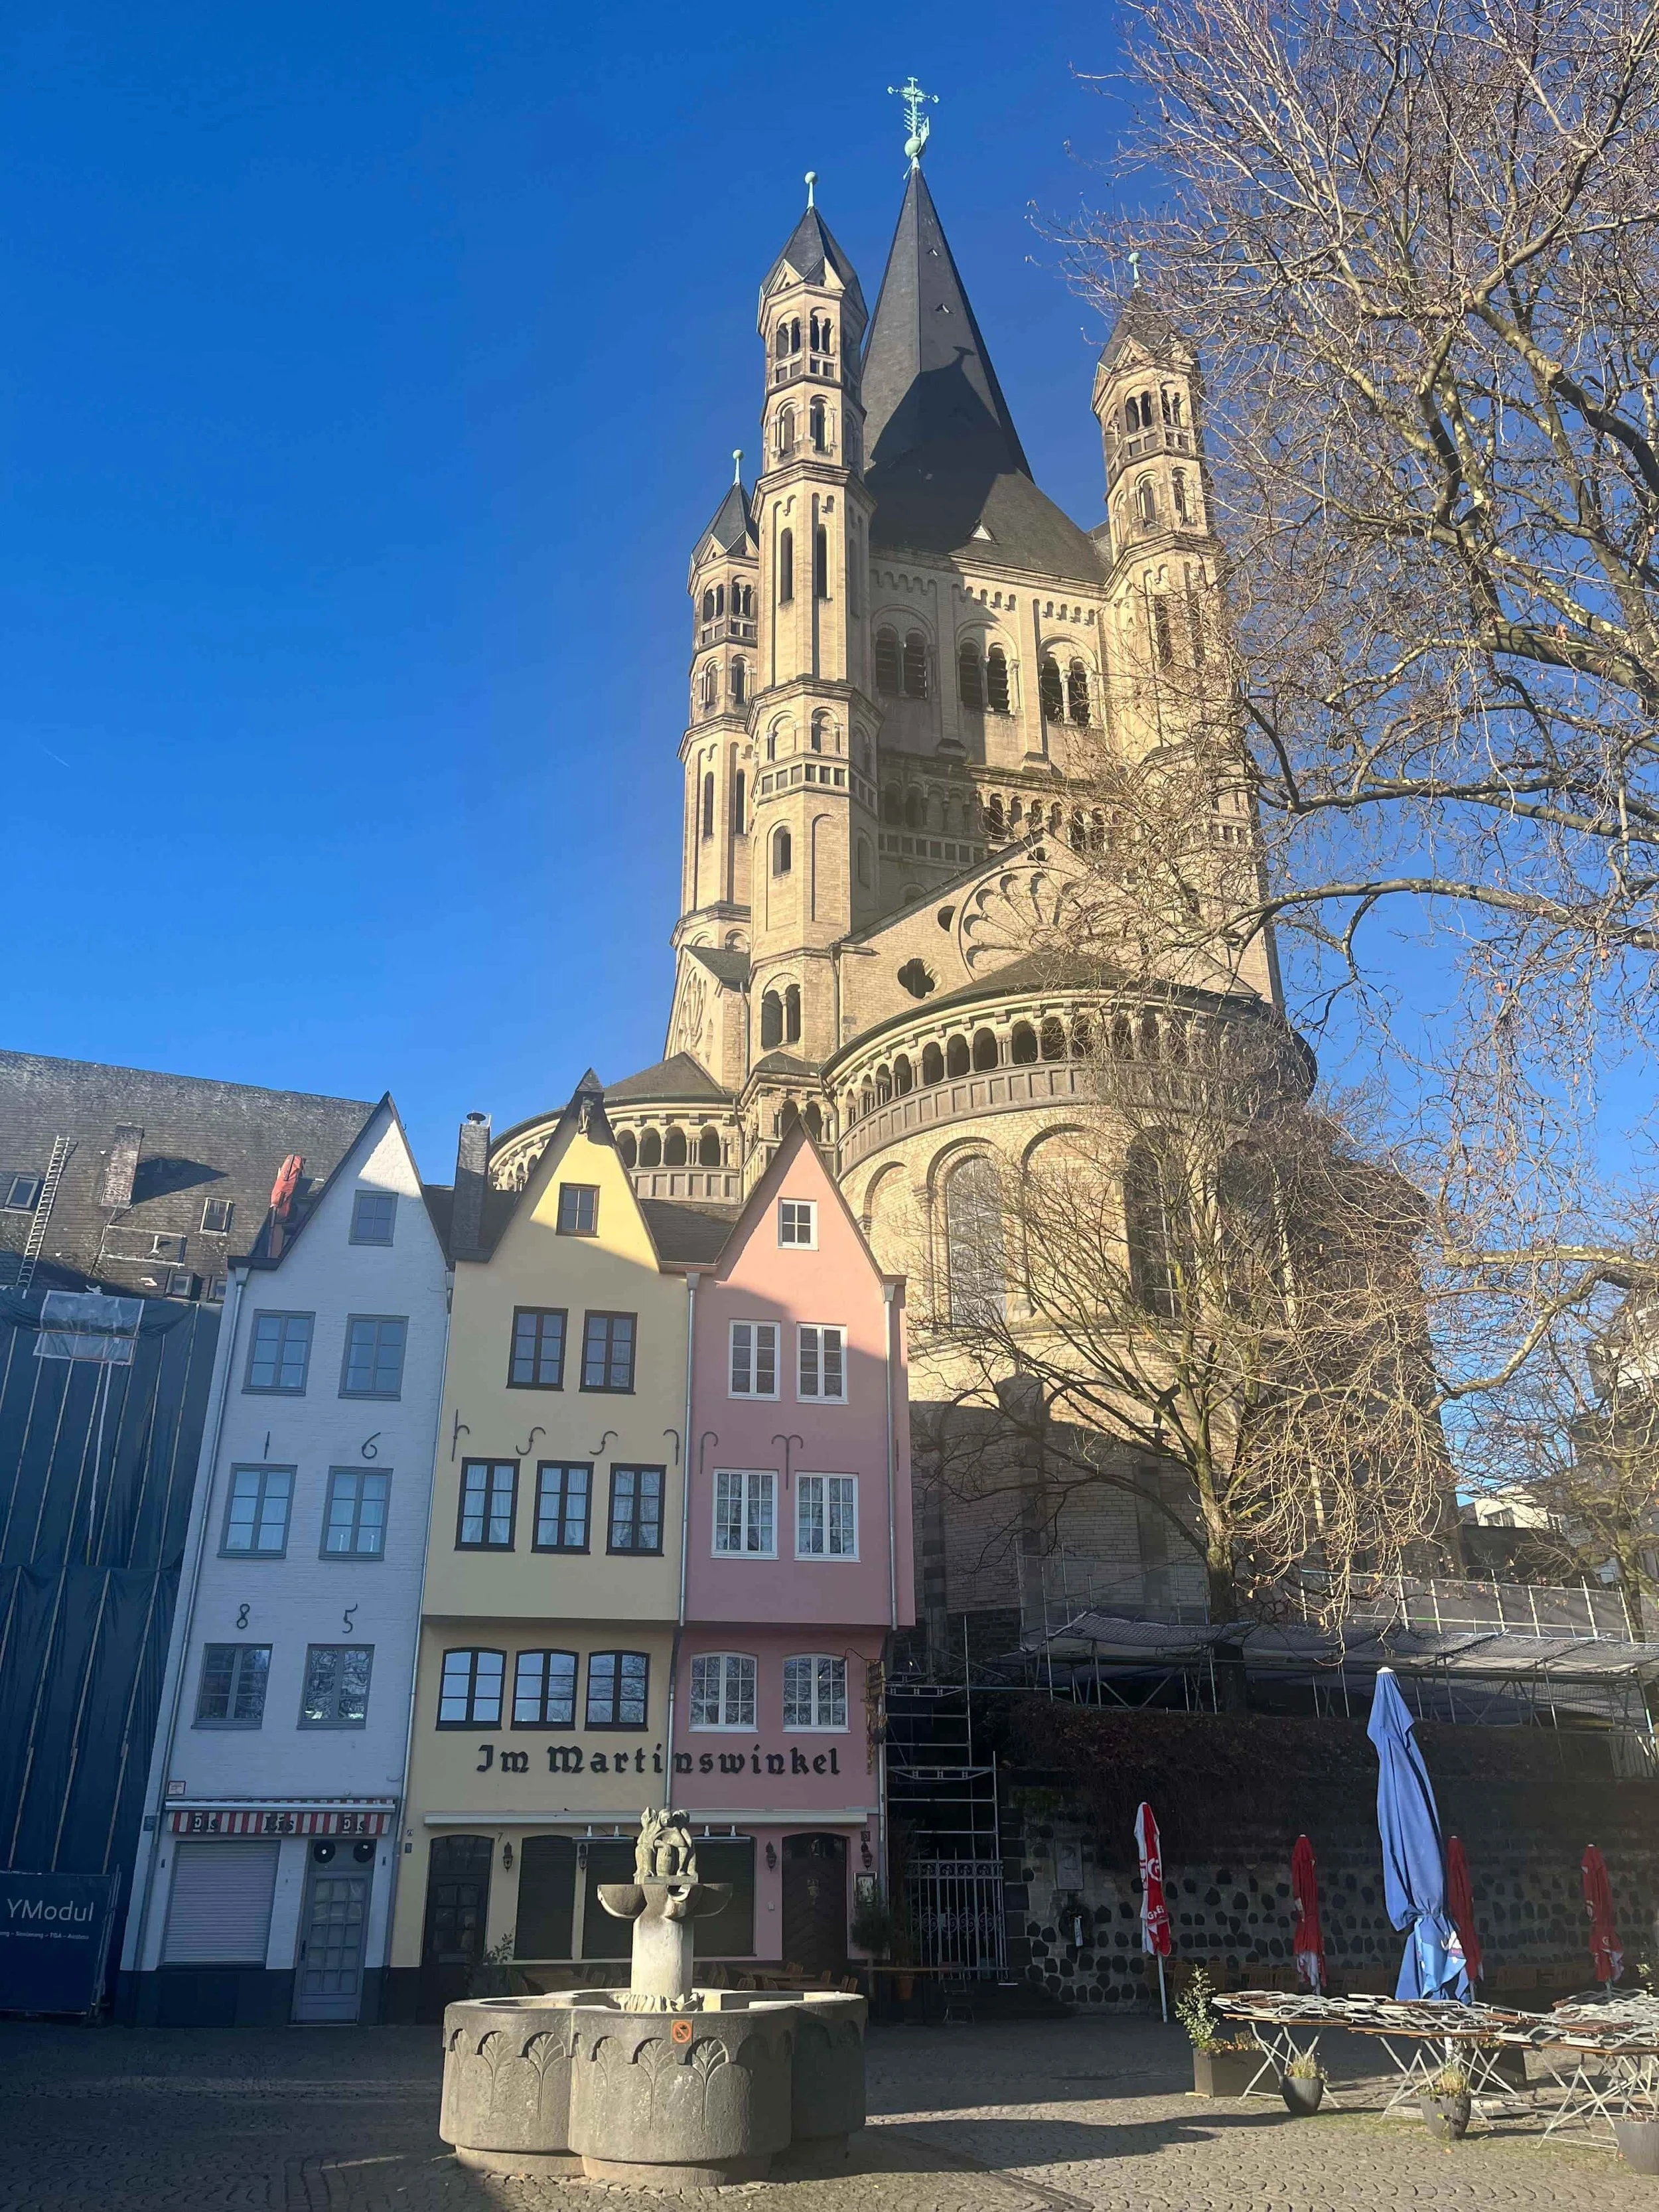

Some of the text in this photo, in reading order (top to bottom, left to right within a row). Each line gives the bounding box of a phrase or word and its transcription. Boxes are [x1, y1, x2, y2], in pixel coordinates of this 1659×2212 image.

[362, 1432, 382, 1459] 6
[236, 1603, 358, 1634] 8 5
[476, 1743, 841, 1775] Im Martinswinkel
[7, 1898, 94, 1922] YModul
